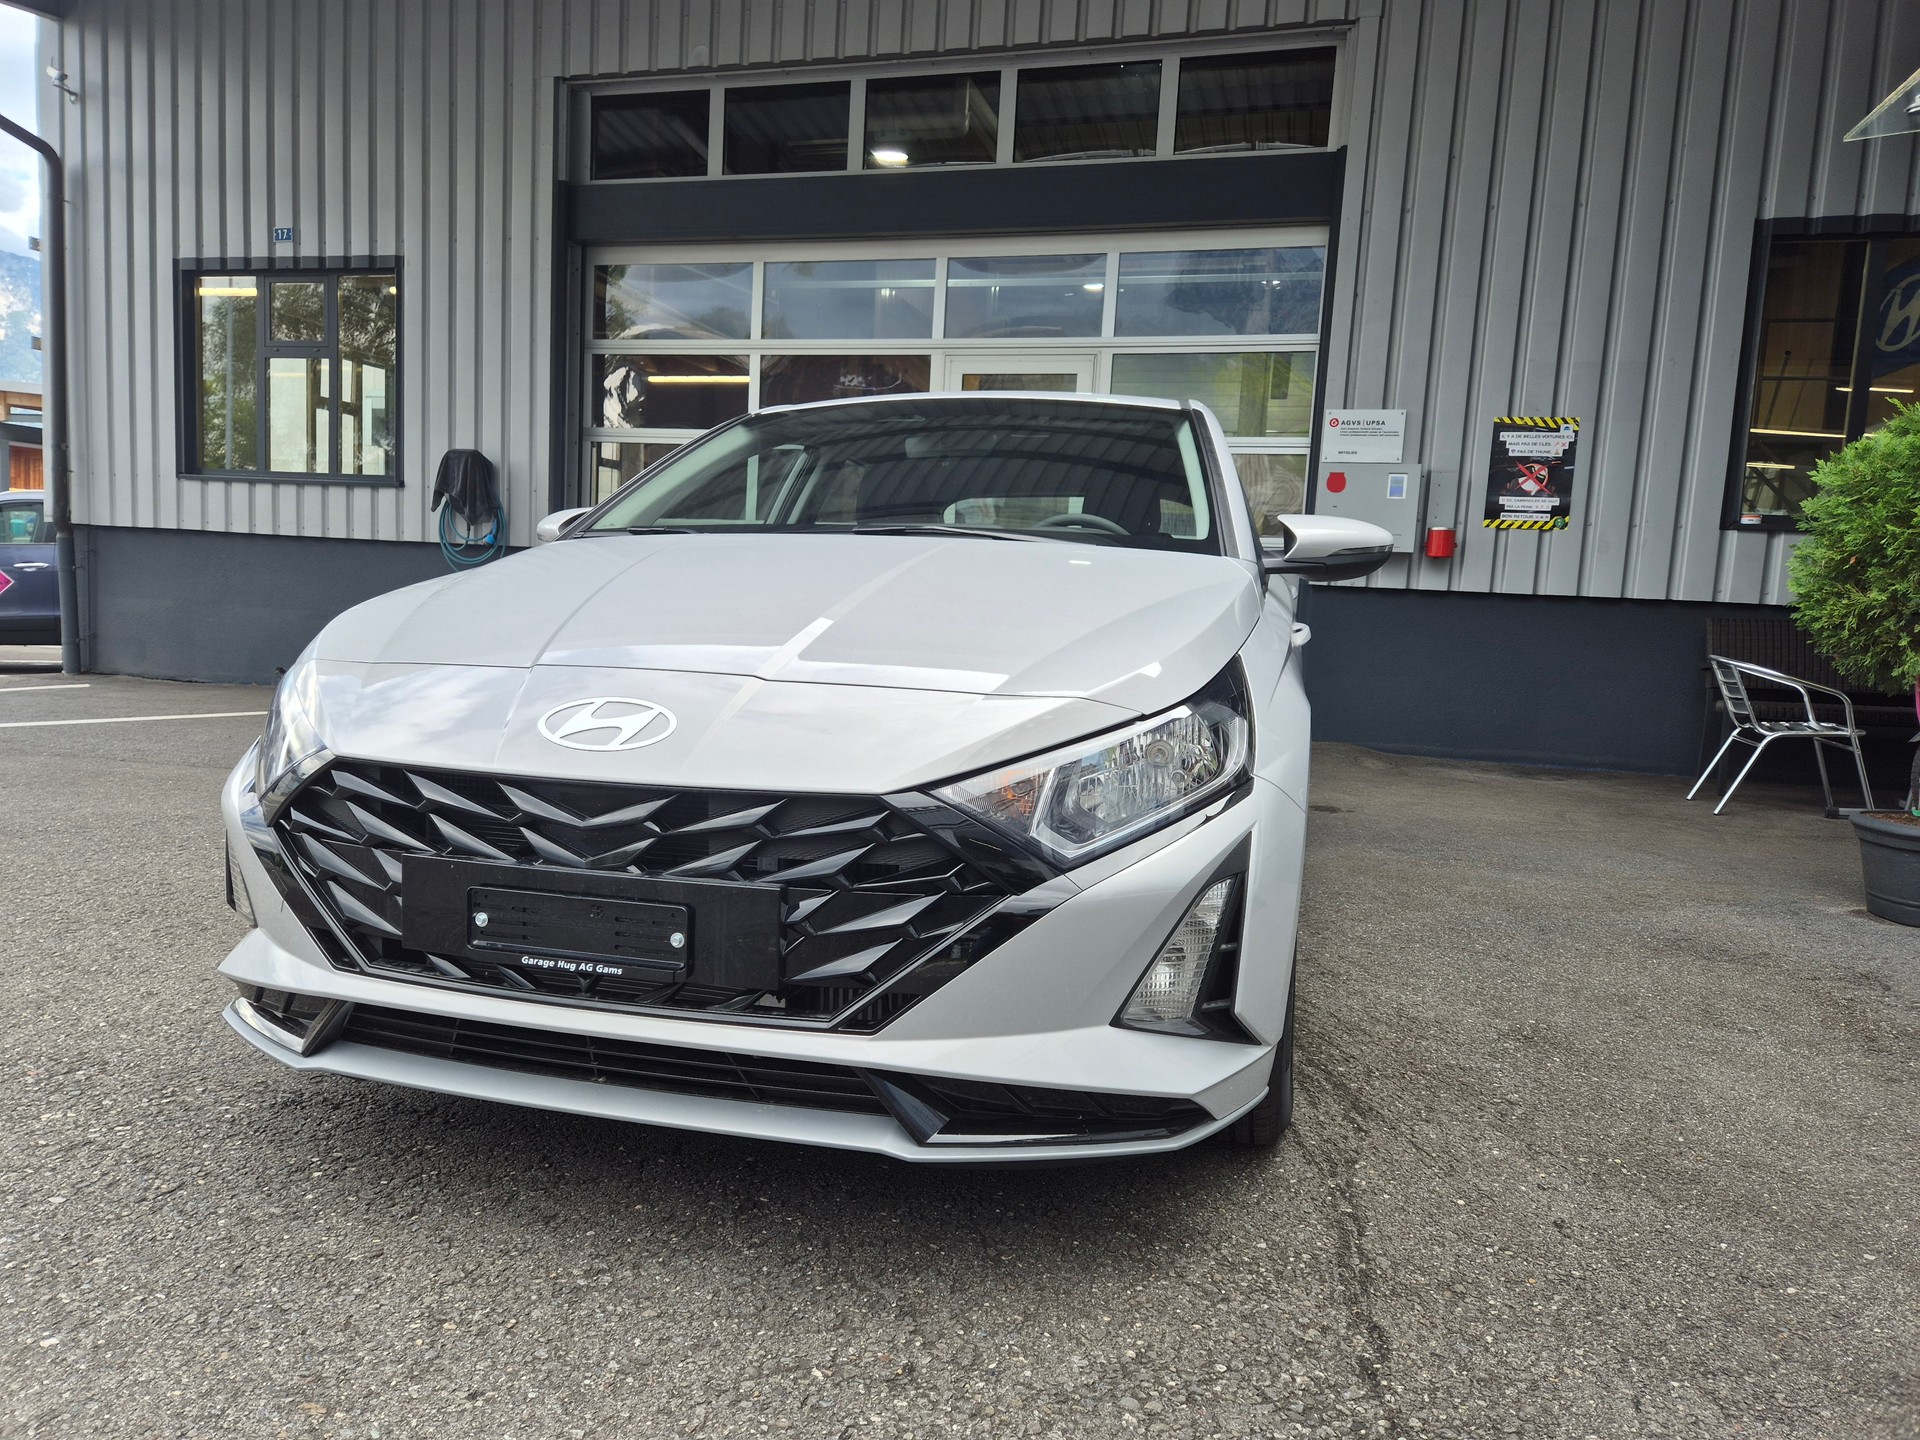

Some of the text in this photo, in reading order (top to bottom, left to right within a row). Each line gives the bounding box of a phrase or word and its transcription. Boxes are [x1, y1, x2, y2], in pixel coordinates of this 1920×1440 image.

[278, 229, 288, 240] 17
[521, 956, 623, 975] Garage Hug AG Gams
